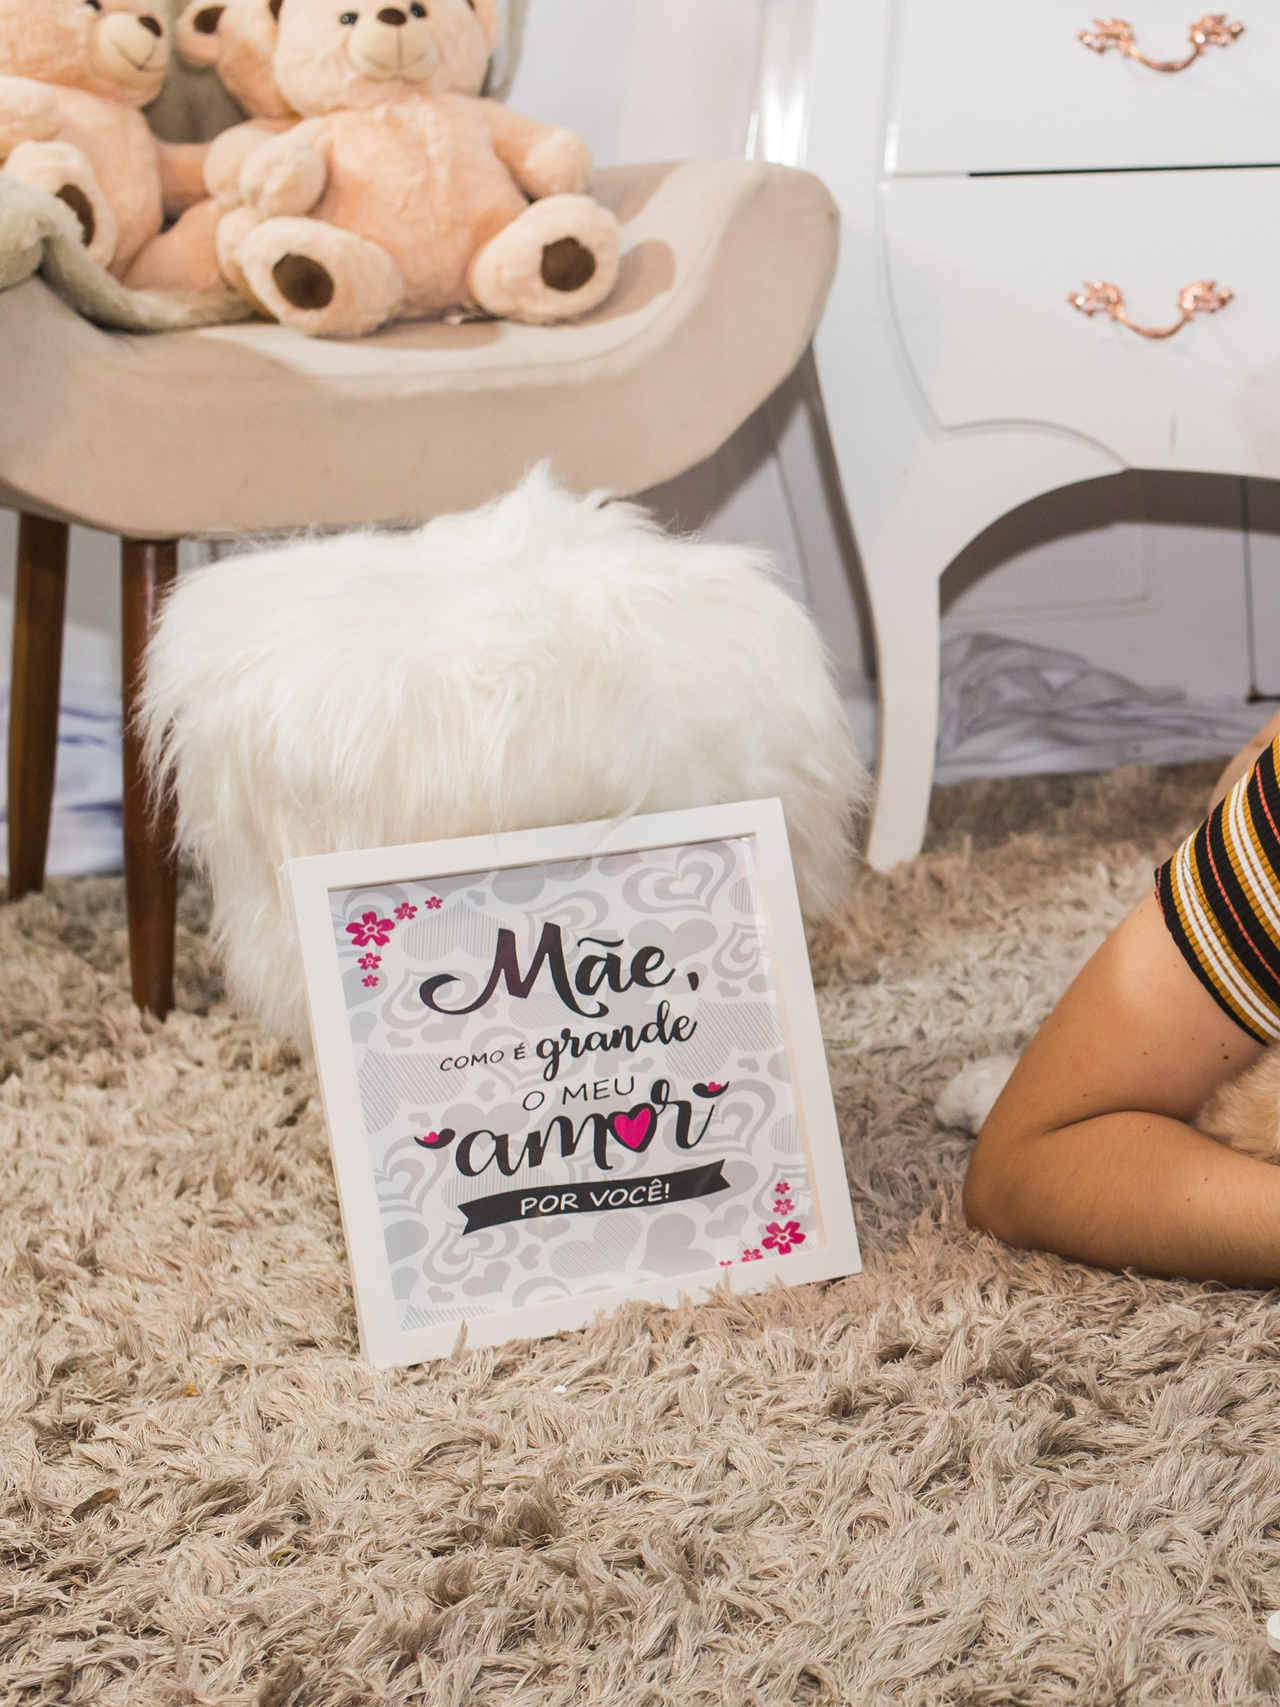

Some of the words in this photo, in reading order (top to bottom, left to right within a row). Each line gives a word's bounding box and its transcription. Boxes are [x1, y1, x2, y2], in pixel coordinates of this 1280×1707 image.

[419, 922, 699, 1018] Mãe,
[439, 1050, 505, 1072] COMO
[513, 1042, 526, 1061] É
[535, 1000, 698, 1082] grande
[522, 1090, 545, 1111] O
[562, 1075, 635, 1105] MEU
[520, 1193, 579, 1216] POR
[589, 1179, 671, 1208] VOCÊ!
